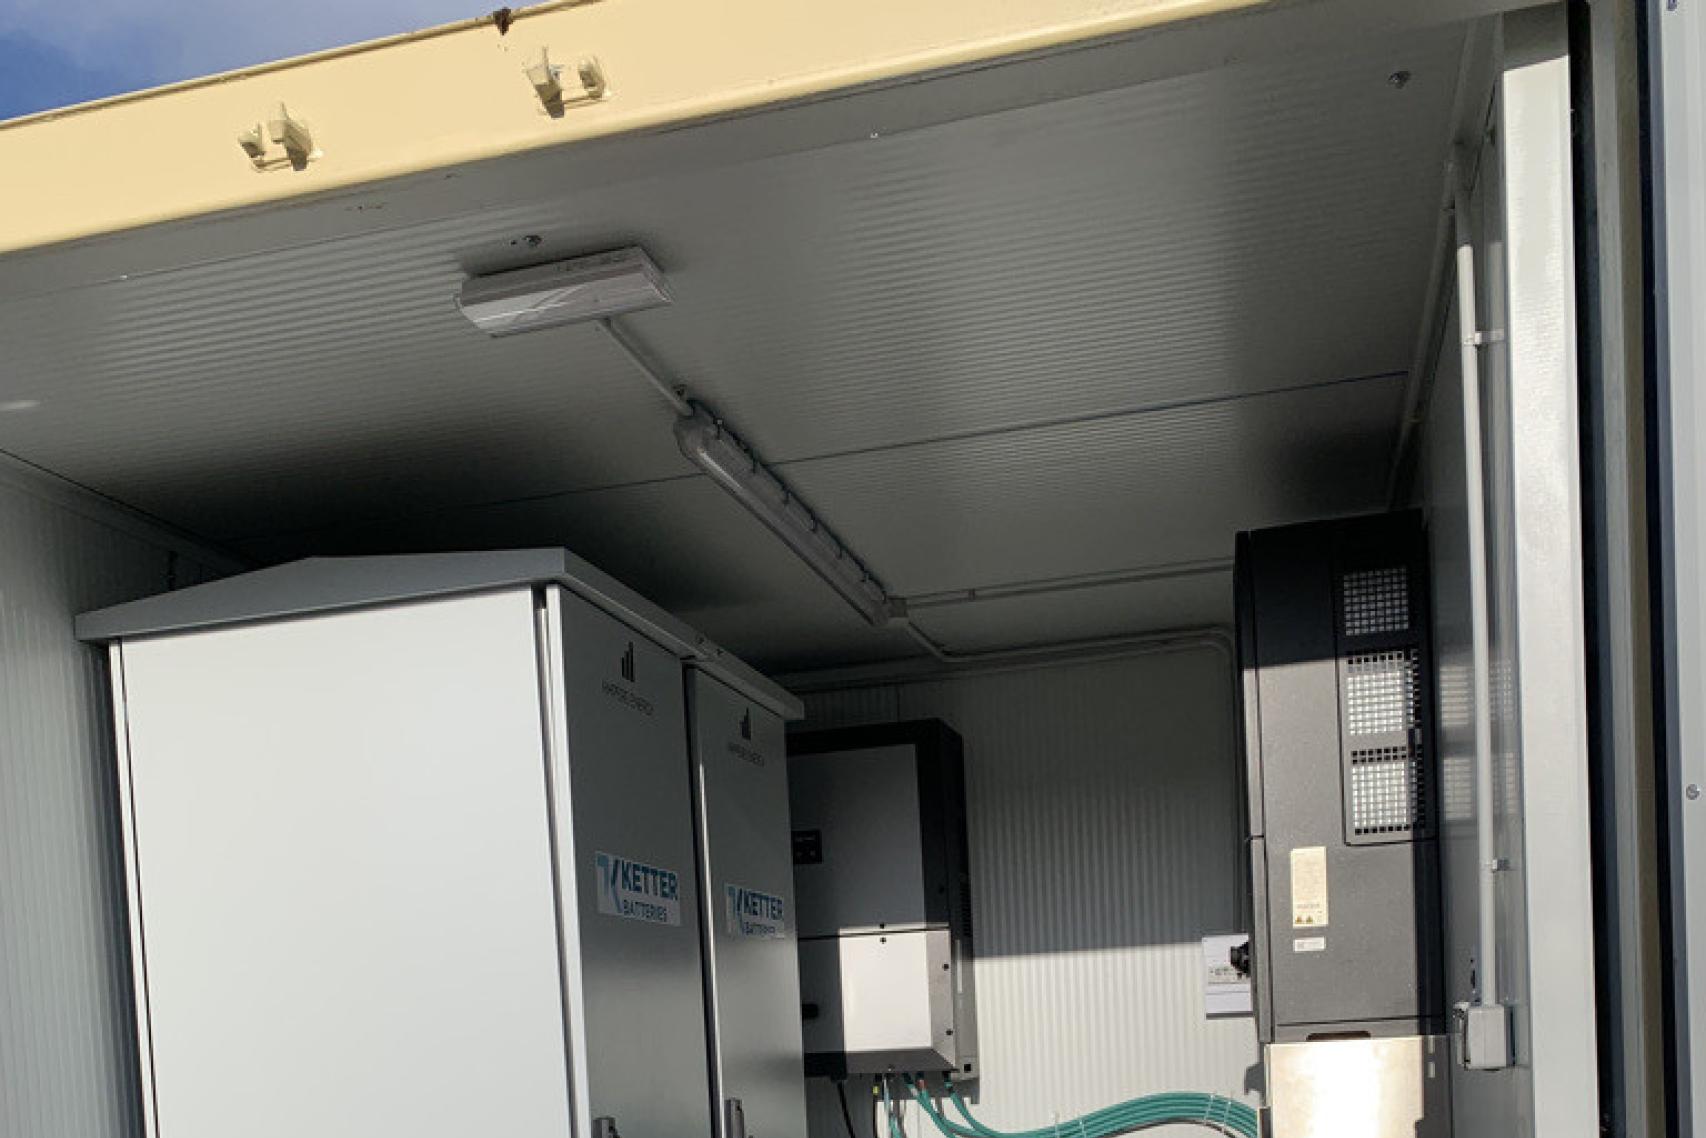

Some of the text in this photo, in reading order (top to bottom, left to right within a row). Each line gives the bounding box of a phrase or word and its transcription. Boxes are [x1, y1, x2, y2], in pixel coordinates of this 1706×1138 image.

[621, 859, 678, 901] KETTER
[623, 899, 667, 923] BATTERIES
[743, 890, 783, 921] KETTER
